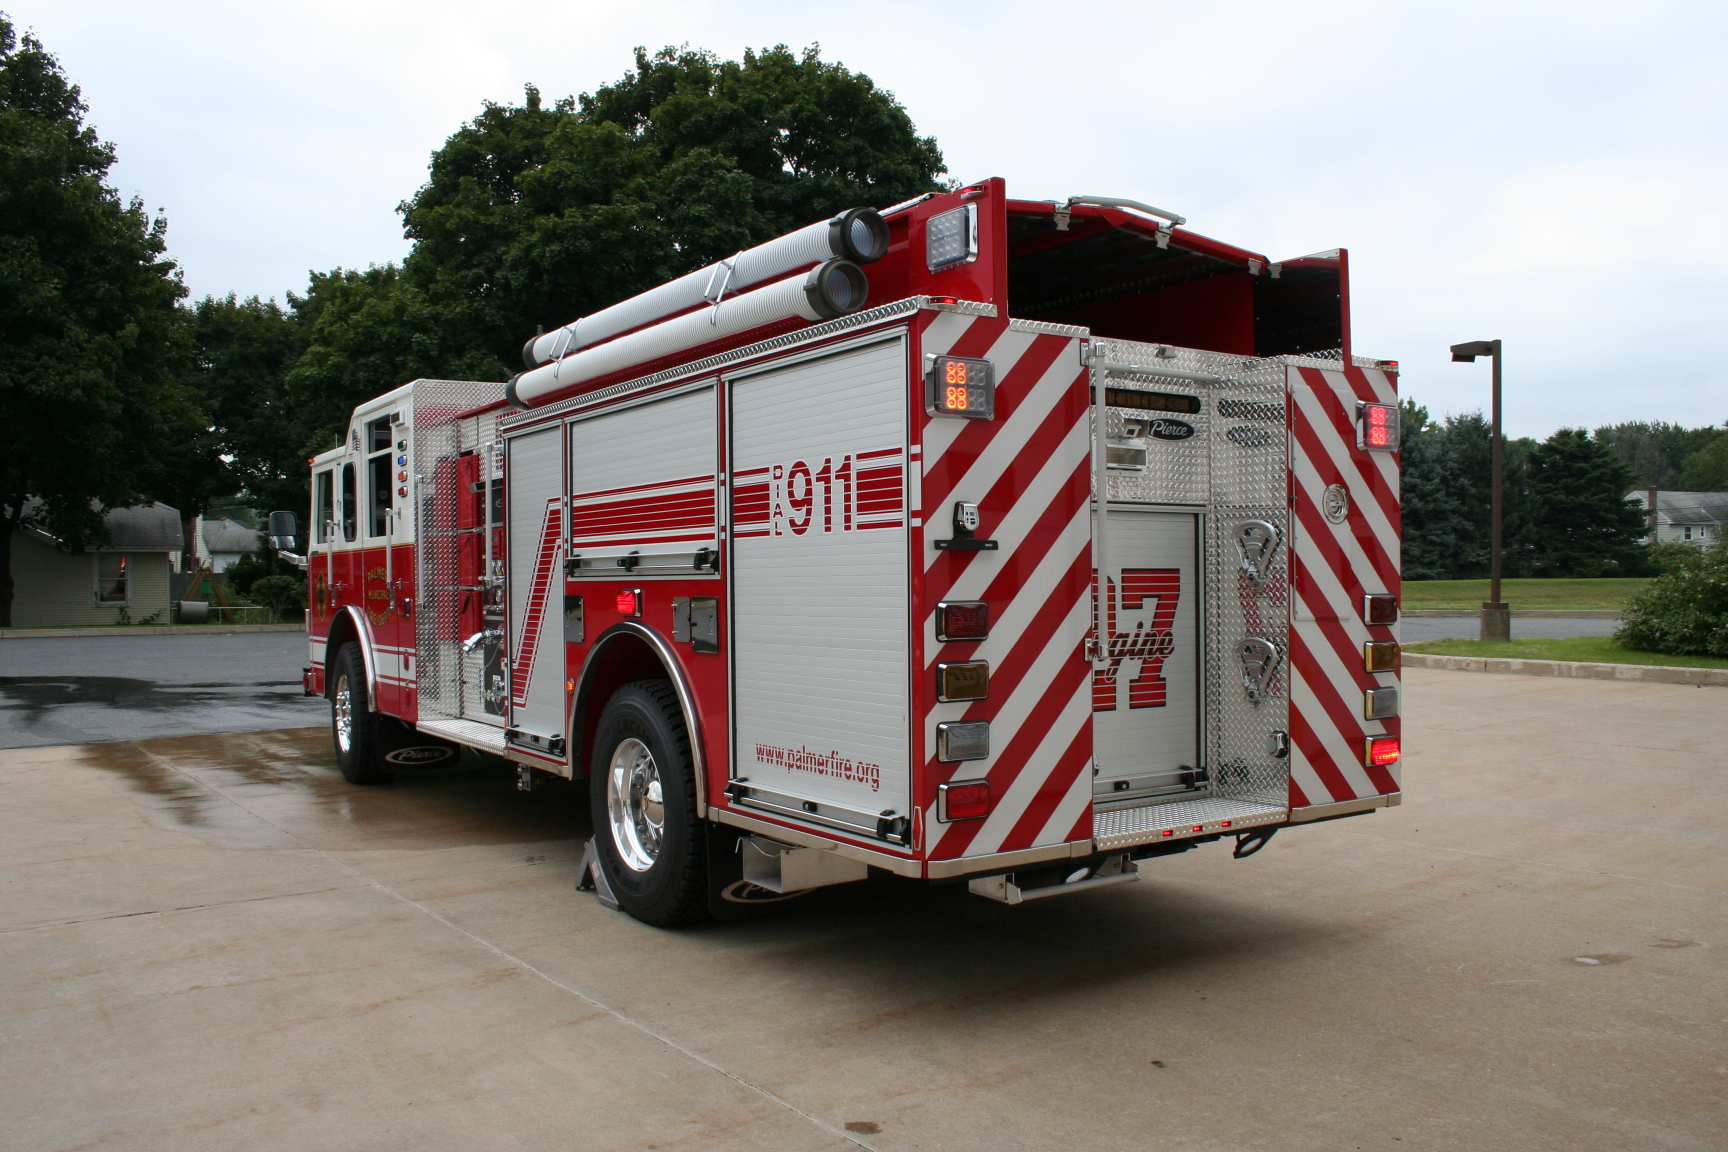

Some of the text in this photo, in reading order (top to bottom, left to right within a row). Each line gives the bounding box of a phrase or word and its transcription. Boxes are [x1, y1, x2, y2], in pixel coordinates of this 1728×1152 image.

[1151, 420, 1188, 436] Pierce
[773, 455, 851, 536] DIAL 911
[398, 750, 442, 761] Pierce
[755, 743, 880, 792] www.palmerfire.org
